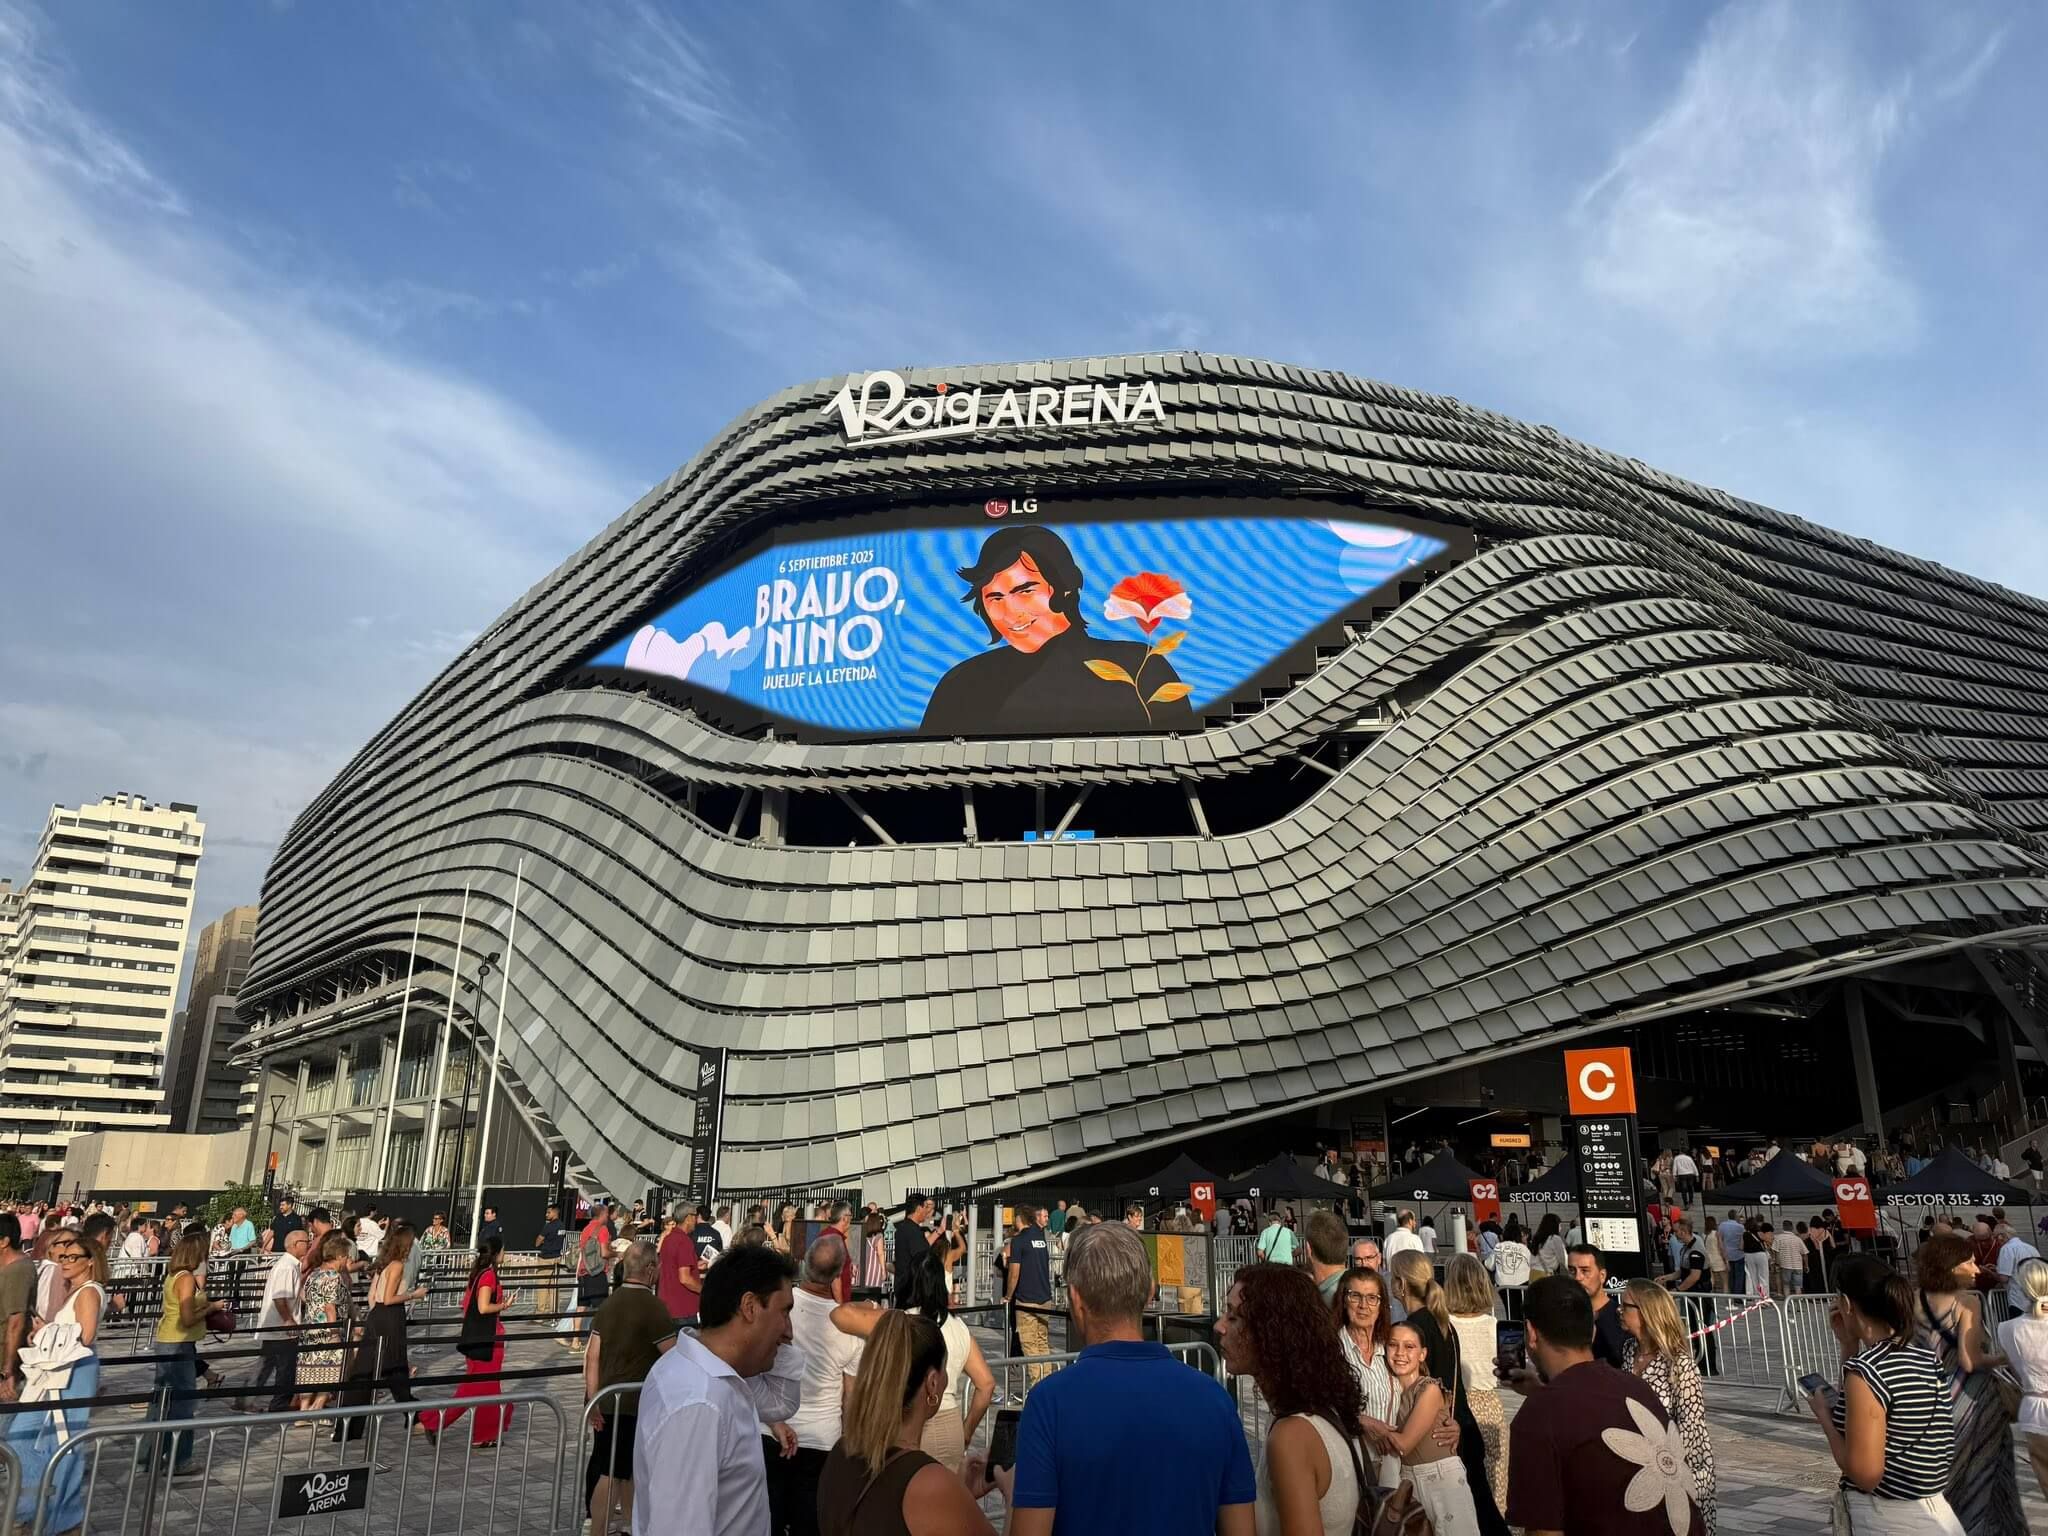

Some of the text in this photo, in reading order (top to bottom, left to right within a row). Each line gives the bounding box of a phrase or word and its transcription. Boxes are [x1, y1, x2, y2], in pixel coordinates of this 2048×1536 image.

[821, 370, 1166, 447] Roig ARENA
[1011, 498, 1038, 514] LG
[779, 550, 874, 573] 6 SEPTIEMBRE 2025
[765, 614, 883, 670] NINO
[763, 665, 877, 690] VUELVE LA LEYENDA
[1579, 1061, 1616, 1101] C
[553, 1156, 560, 1174] B
[1194, 1186, 1211, 1200] C1
[1249, 1188, 1260, 1197] C1
[1413, 1190, 1429, 1200] C2
[1472, 1183, 1497, 1199] C2
[1509, 1191, 1551, 1203] SECTOR
[1553, 1191, 1571, 1202] 301
[1760, 1194, 1780, 1205] C2
[1837, 1182, 1869, 1201] C2
[1887, 1194, 1945, 1206] SECTOR
[1948, 1193, 1971, 1205] 313
[1981, 1194, 2005, 1206] 319
[299, 1473, 350, 1502] Roig
[306, 1492, 346, 1515] ARENA
